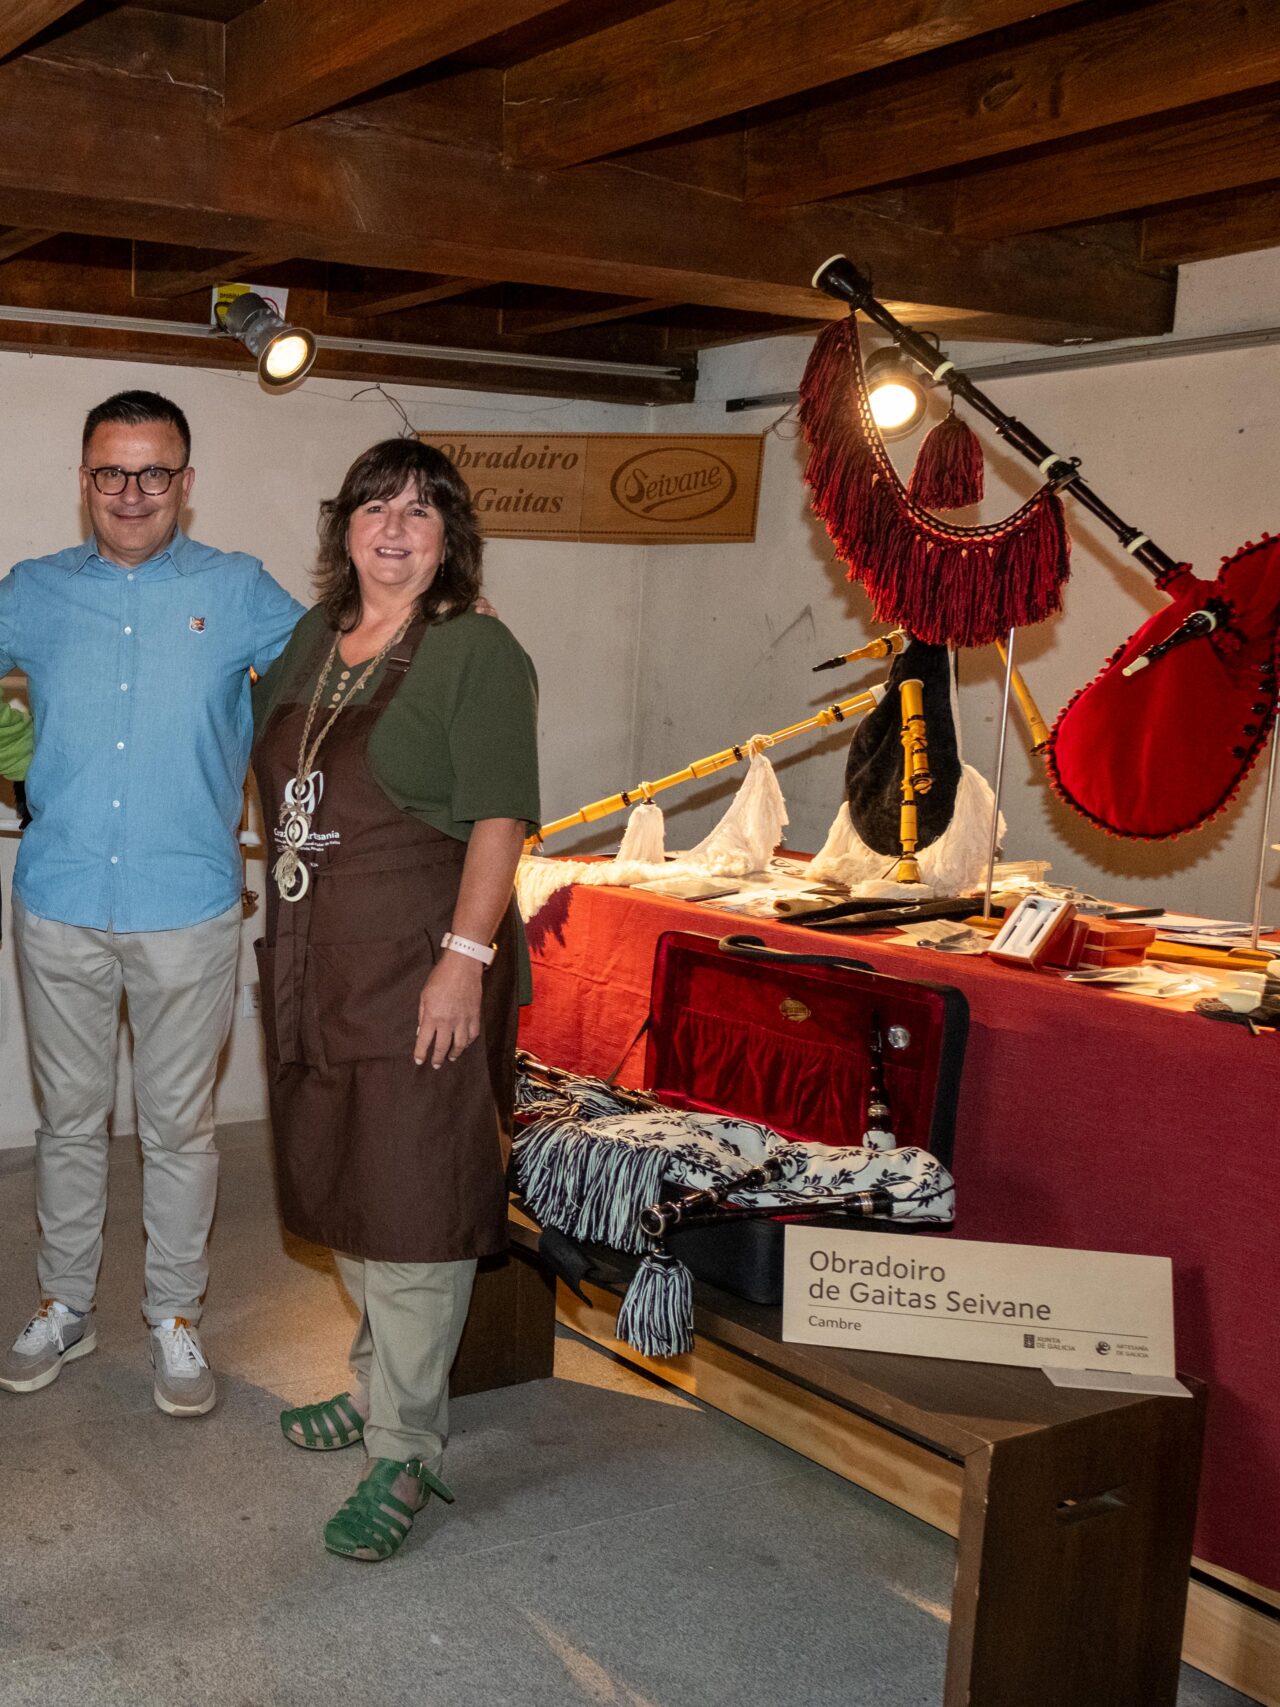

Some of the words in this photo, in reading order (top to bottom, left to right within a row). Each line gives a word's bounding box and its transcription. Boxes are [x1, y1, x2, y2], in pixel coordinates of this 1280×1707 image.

[624, 465, 723, 505] Seivane
[474, 487, 564, 513] Gaitas
[810, 1250, 946, 1282] Obradoiro
[809, 1278, 840, 1301] de
[850, 1281, 937, 1310] Gaitas
[946, 1291, 1052, 1321] Seivane
[808, 1315, 862, 1331] Cambre
[1047, 1343, 1076, 1351] GALICIA
